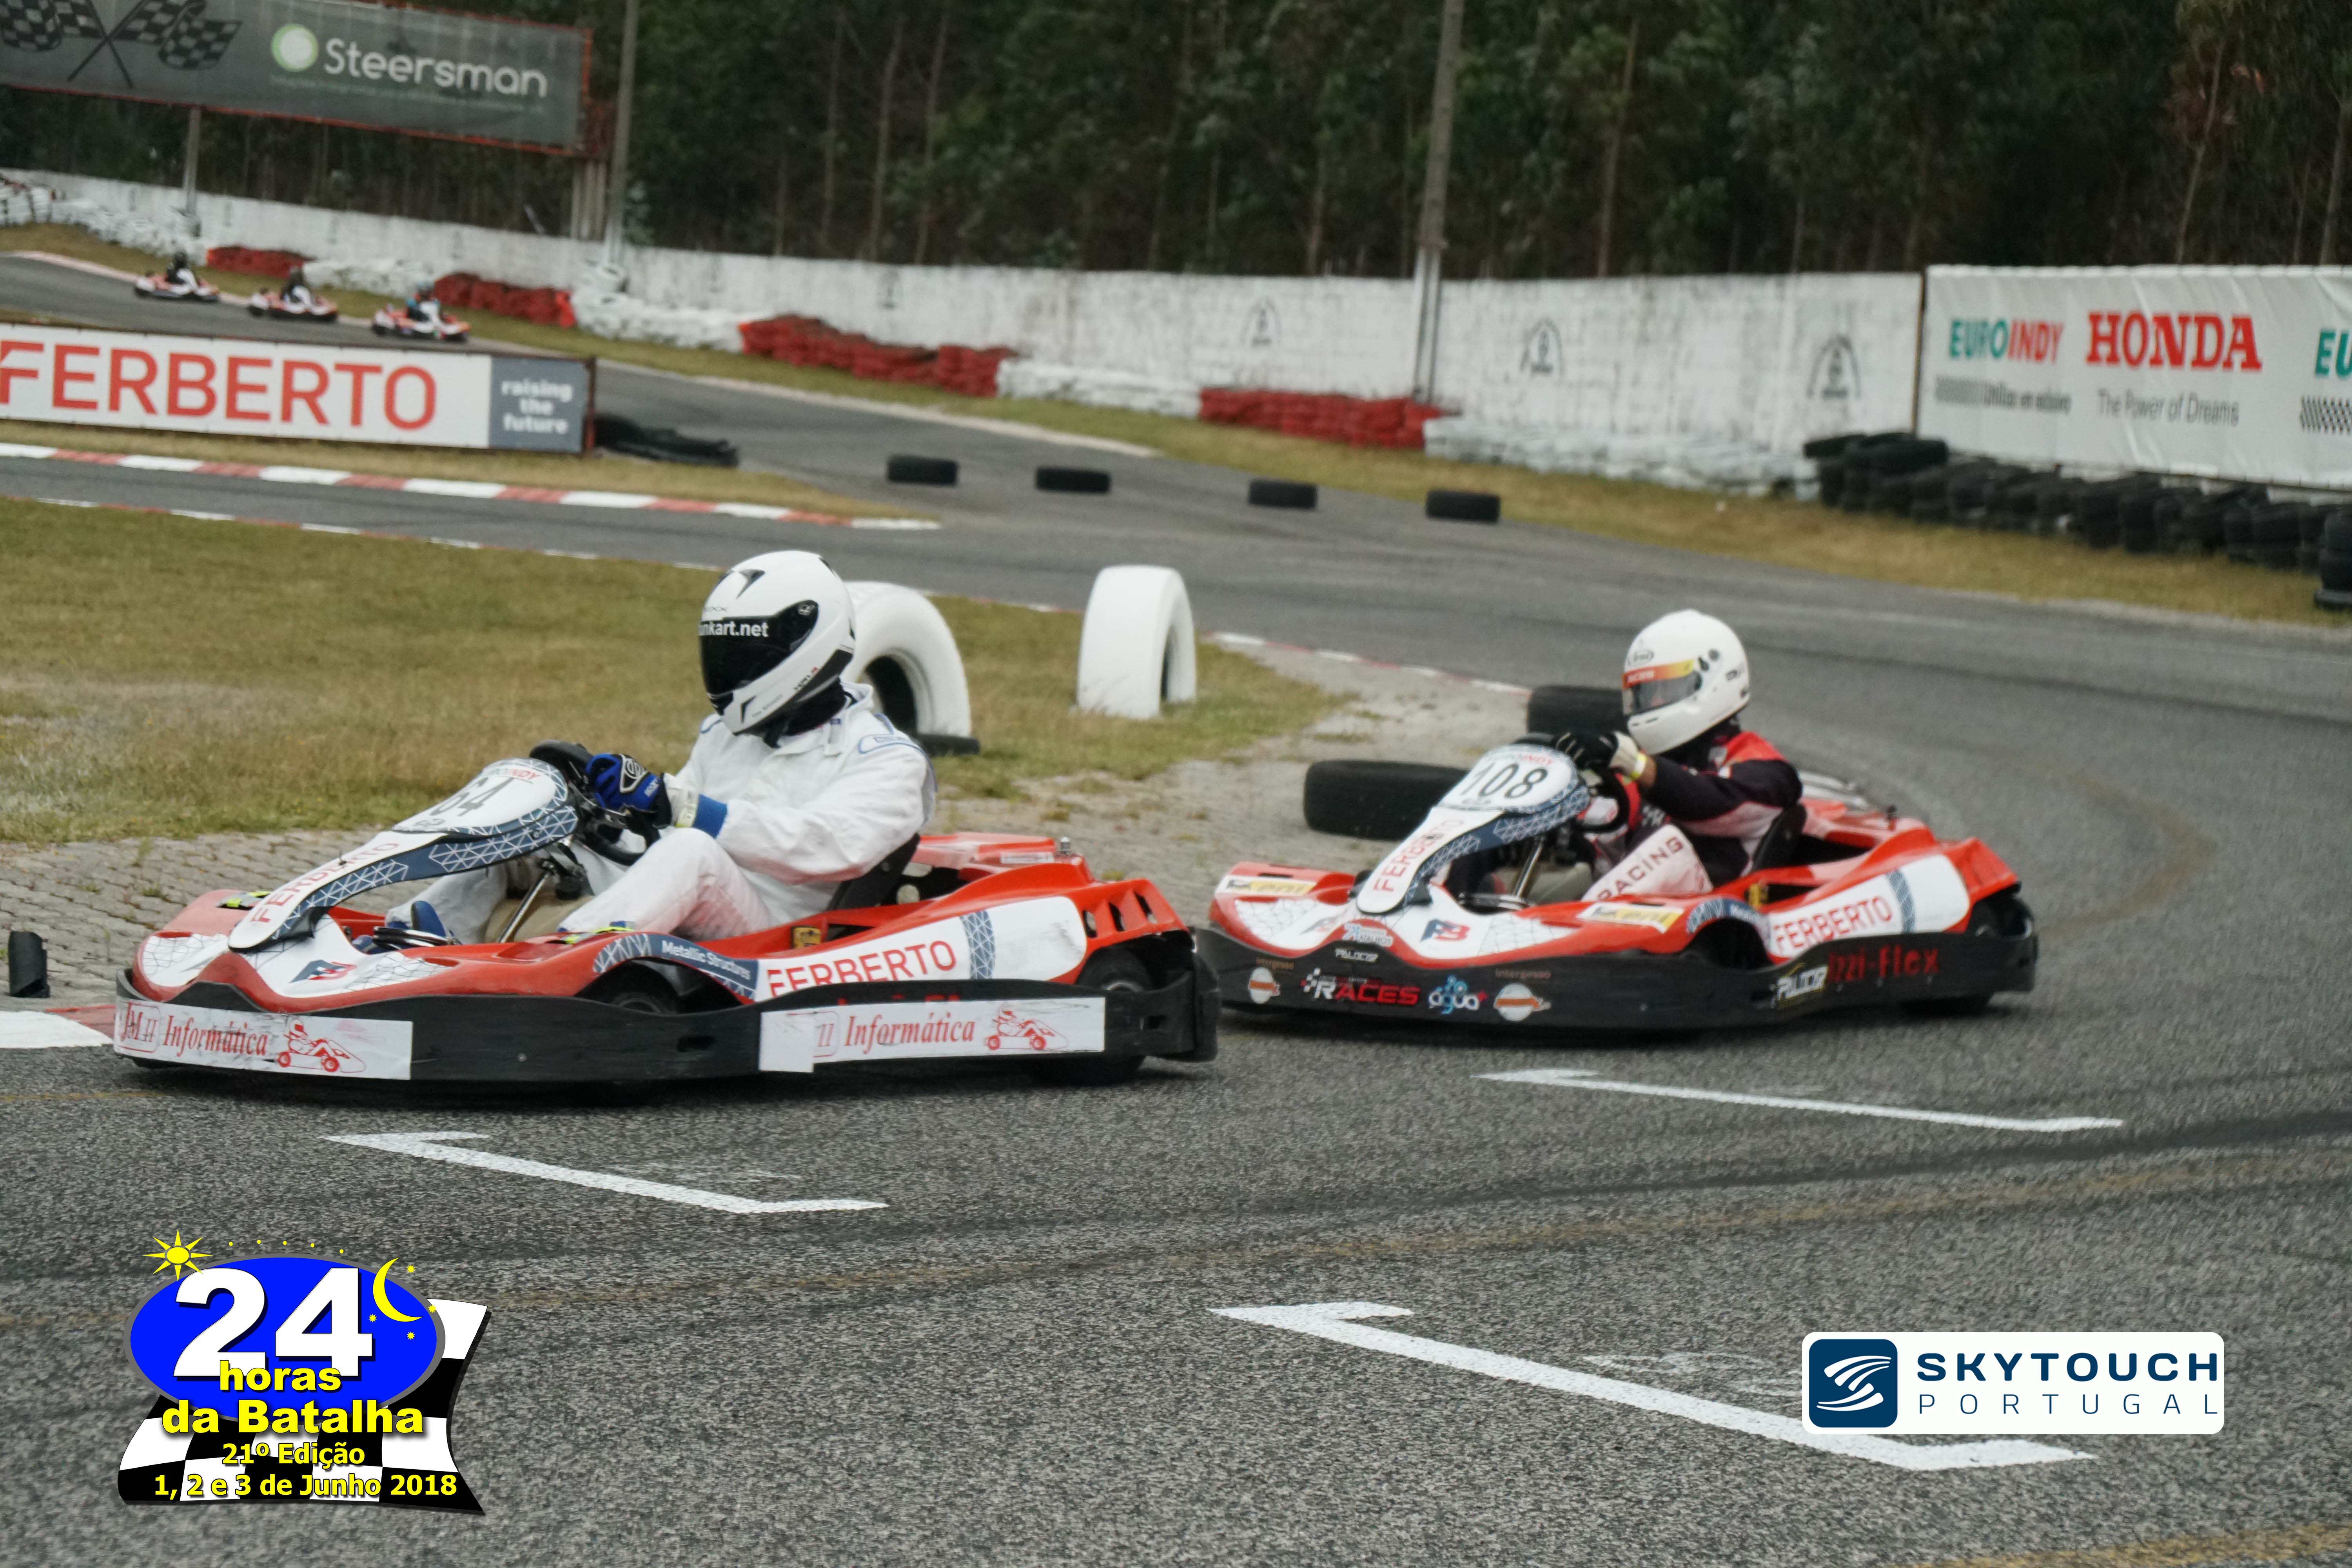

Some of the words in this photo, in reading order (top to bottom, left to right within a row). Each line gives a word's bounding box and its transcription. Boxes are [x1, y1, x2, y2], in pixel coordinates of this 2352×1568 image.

[323, 38, 547, 98] Steersman
[1949, 318, 2064, 365] EUROINDY
[2086, 312, 2262, 371] HONDA
[0, 340, 436, 430] FERBERTO
[502, 378, 573, 403] raising
[503, 413, 567, 434] future
[519, 398, 553, 416] the
[2098, 388, 2121, 418] The
[2125, 390, 2164, 420] Power
[2168, 392, 2184, 422] of
[2186, 392, 2239, 426] Dreams
[1460, 762, 1548, 799] 108
[1773, 896, 1893, 952] FERBERTO
[662, 940, 705, 962] Metallic
[706, 952, 751, 980] Structures
[767, 940, 956, 998] FERBERTO
[1314, 981, 1421, 1005] RACES
[163, 1015, 268, 1056] Informática
[844, 1013, 976, 1054] Informática
